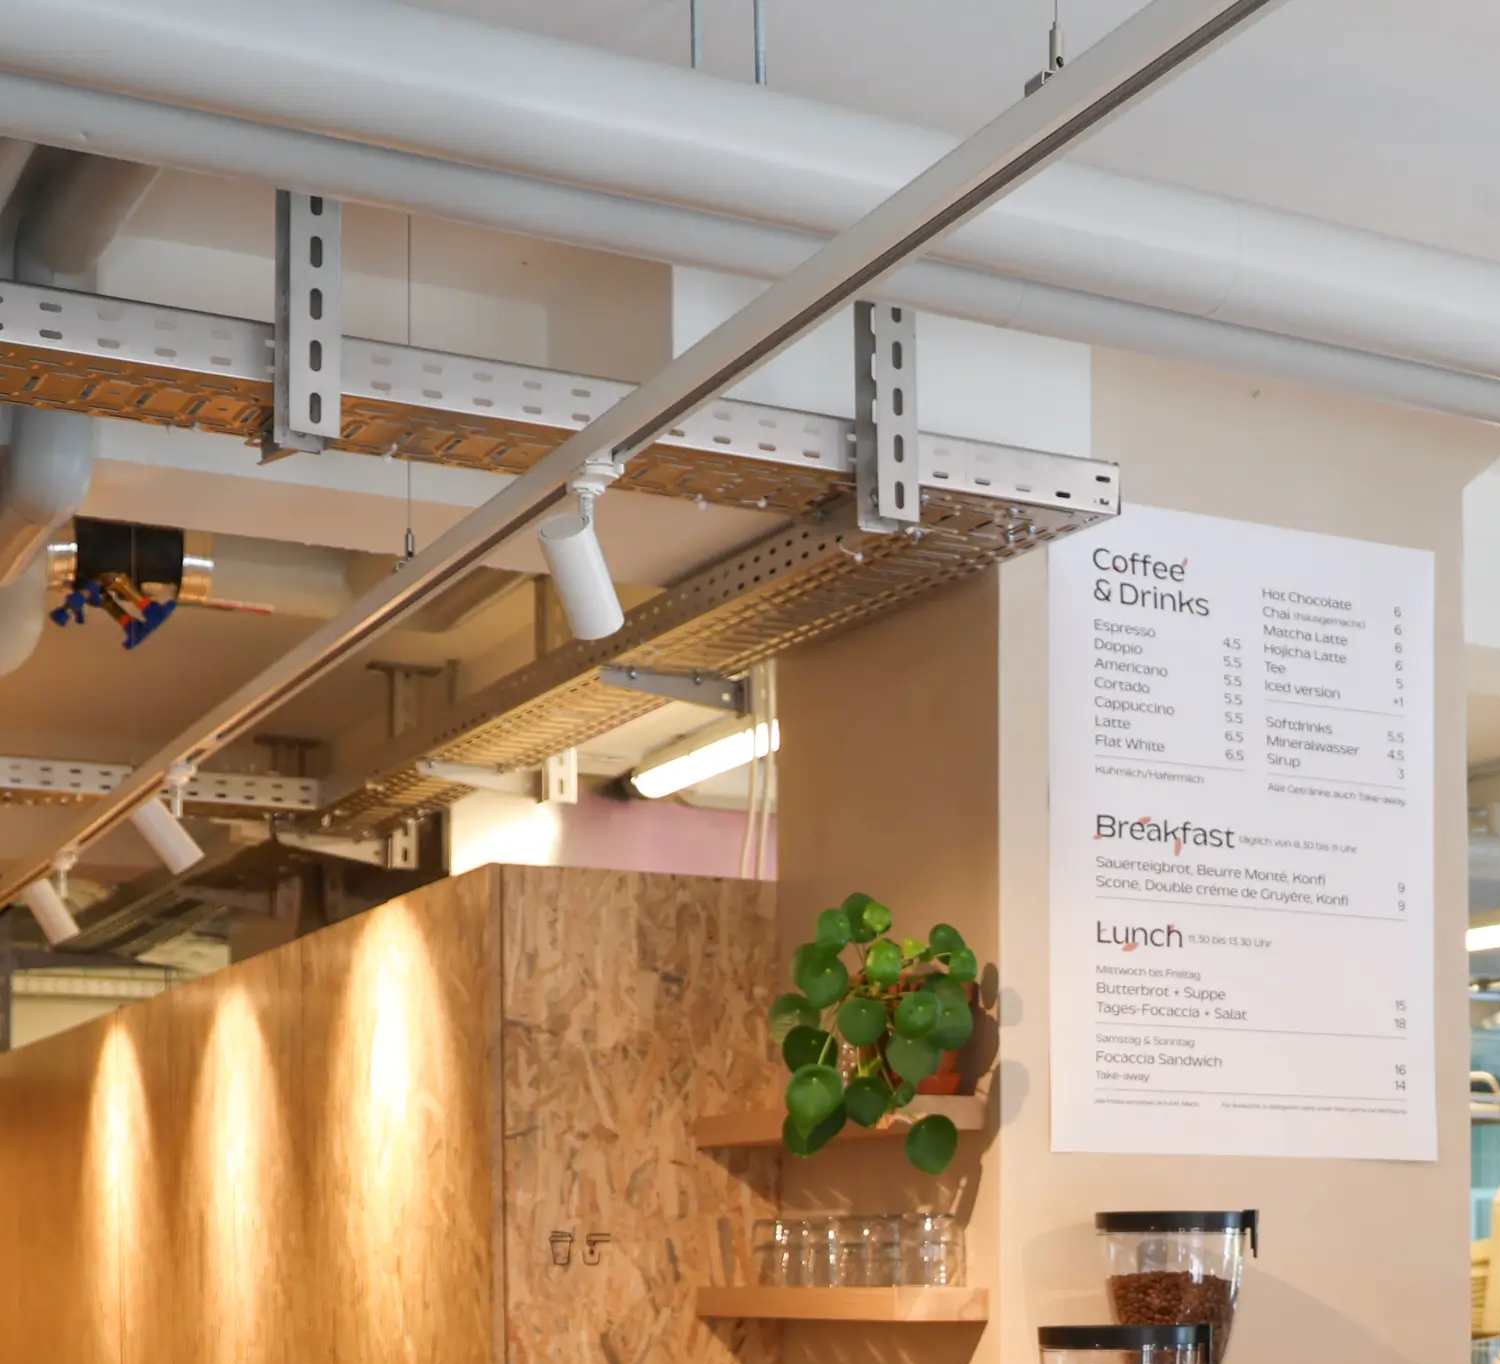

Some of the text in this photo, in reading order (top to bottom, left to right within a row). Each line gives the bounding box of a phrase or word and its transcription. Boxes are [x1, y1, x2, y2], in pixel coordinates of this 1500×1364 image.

[1092, 547, 1185, 582] Coffee
[1093, 578, 1210, 617] & Drinks
[1262, 588, 1402, 618] Hot Chocolate 6
[1094, 618, 1241, 650] Espresso 4.5
[1262, 605, 1290, 620] Chai
[1393, 624, 1402, 636] 6
[1094, 637, 1242, 669] Doppio 5.5
[1263, 624, 1403, 654] Matcha Latte 6
[1263, 643, 1404, 671] Hojicha Latte 6
[1094, 657, 1242, 687] Americano 5.5
[1264, 660, 1404, 690] Tee 5
[1094, 676, 1243, 706] Cortado 5.5
[1264, 679, 1291, 693] Iced
[1293, 684, 1341, 700] version
[1094, 695, 1244, 725] Cappuccino 5.5
[1094, 715, 1244, 743] Latte 6.5
[1266, 716, 1405, 743] Softdrinks 5.5
[1094, 733, 1245, 762] Flat White 6.5
[1266, 734, 1405, 761] Mineralwasser 4.5
[1266, 752, 1300, 769] Sirup
[1095, 764, 1205, 785] Kuhmilch/Hafermilch
[1333, 789, 1356, 800] auch
[1096, 814, 1236, 849] Breakfast
[1273, 837, 1292, 849] von
[1145, 878, 1193, 894] Double
[1240, 887, 1258, 899] de
[1316, 893, 1350, 907] Konfi
[1197, 864, 1242, 880] Beurre
[1293, 872, 1327, 887] Konfi
[1397, 882, 1406, 893] 9
[1096, 920, 1183, 948] Lunch
[1212, 934, 1227, 945] bis
[1253, 938, 1272, 949] Uhr
[1096, 964, 1202, 982] Mittwoch bis Freitag
[1096, 981, 1170, 998] Butterbrot
[1183, 986, 1227, 1002] Suppe
[1394, 1000, 1407, 1012] 15
[1096, 1000, 1200, 1019] Tages-Focaccia
[1213, 1007, 1248, 1021] Salat
[1394, 1018, 1407, 1029] 18
[1095, 1033, 1142, 1046] Samstag
[1152, 1036, 1195, 1049] Sonntag
[1095, 1050, 1407, 1076] Focaccia Sandwich 16
[1096, 1070, 1407, 1092] Take-away 14
